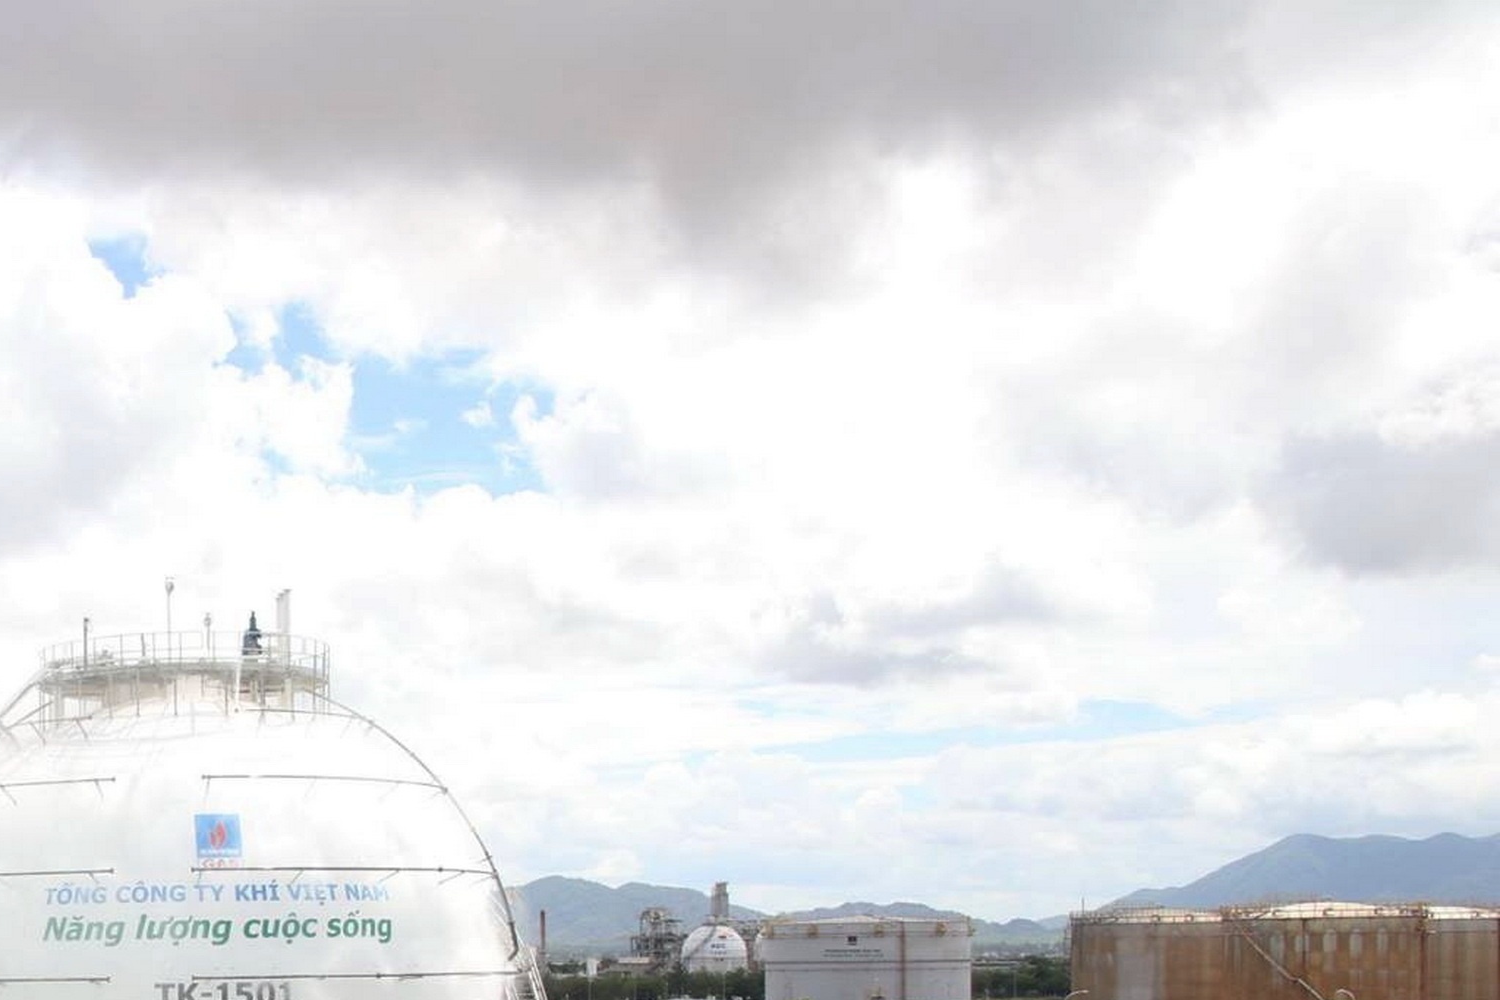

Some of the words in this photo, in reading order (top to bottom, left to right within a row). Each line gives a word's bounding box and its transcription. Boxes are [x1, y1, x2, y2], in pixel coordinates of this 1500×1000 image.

[116, 881, 187, 903] CÔNG
[194, 885, 224, 902] TY
[235, 880, 281, 901] KHÍ
[344, 884, 390, 901] NAM
[43, 915, 126, 947] Năng
[136, 914, 232, 945] lượng
[243, 912, 318, 944] cuộc
[326, 910, 392, 943] sống
